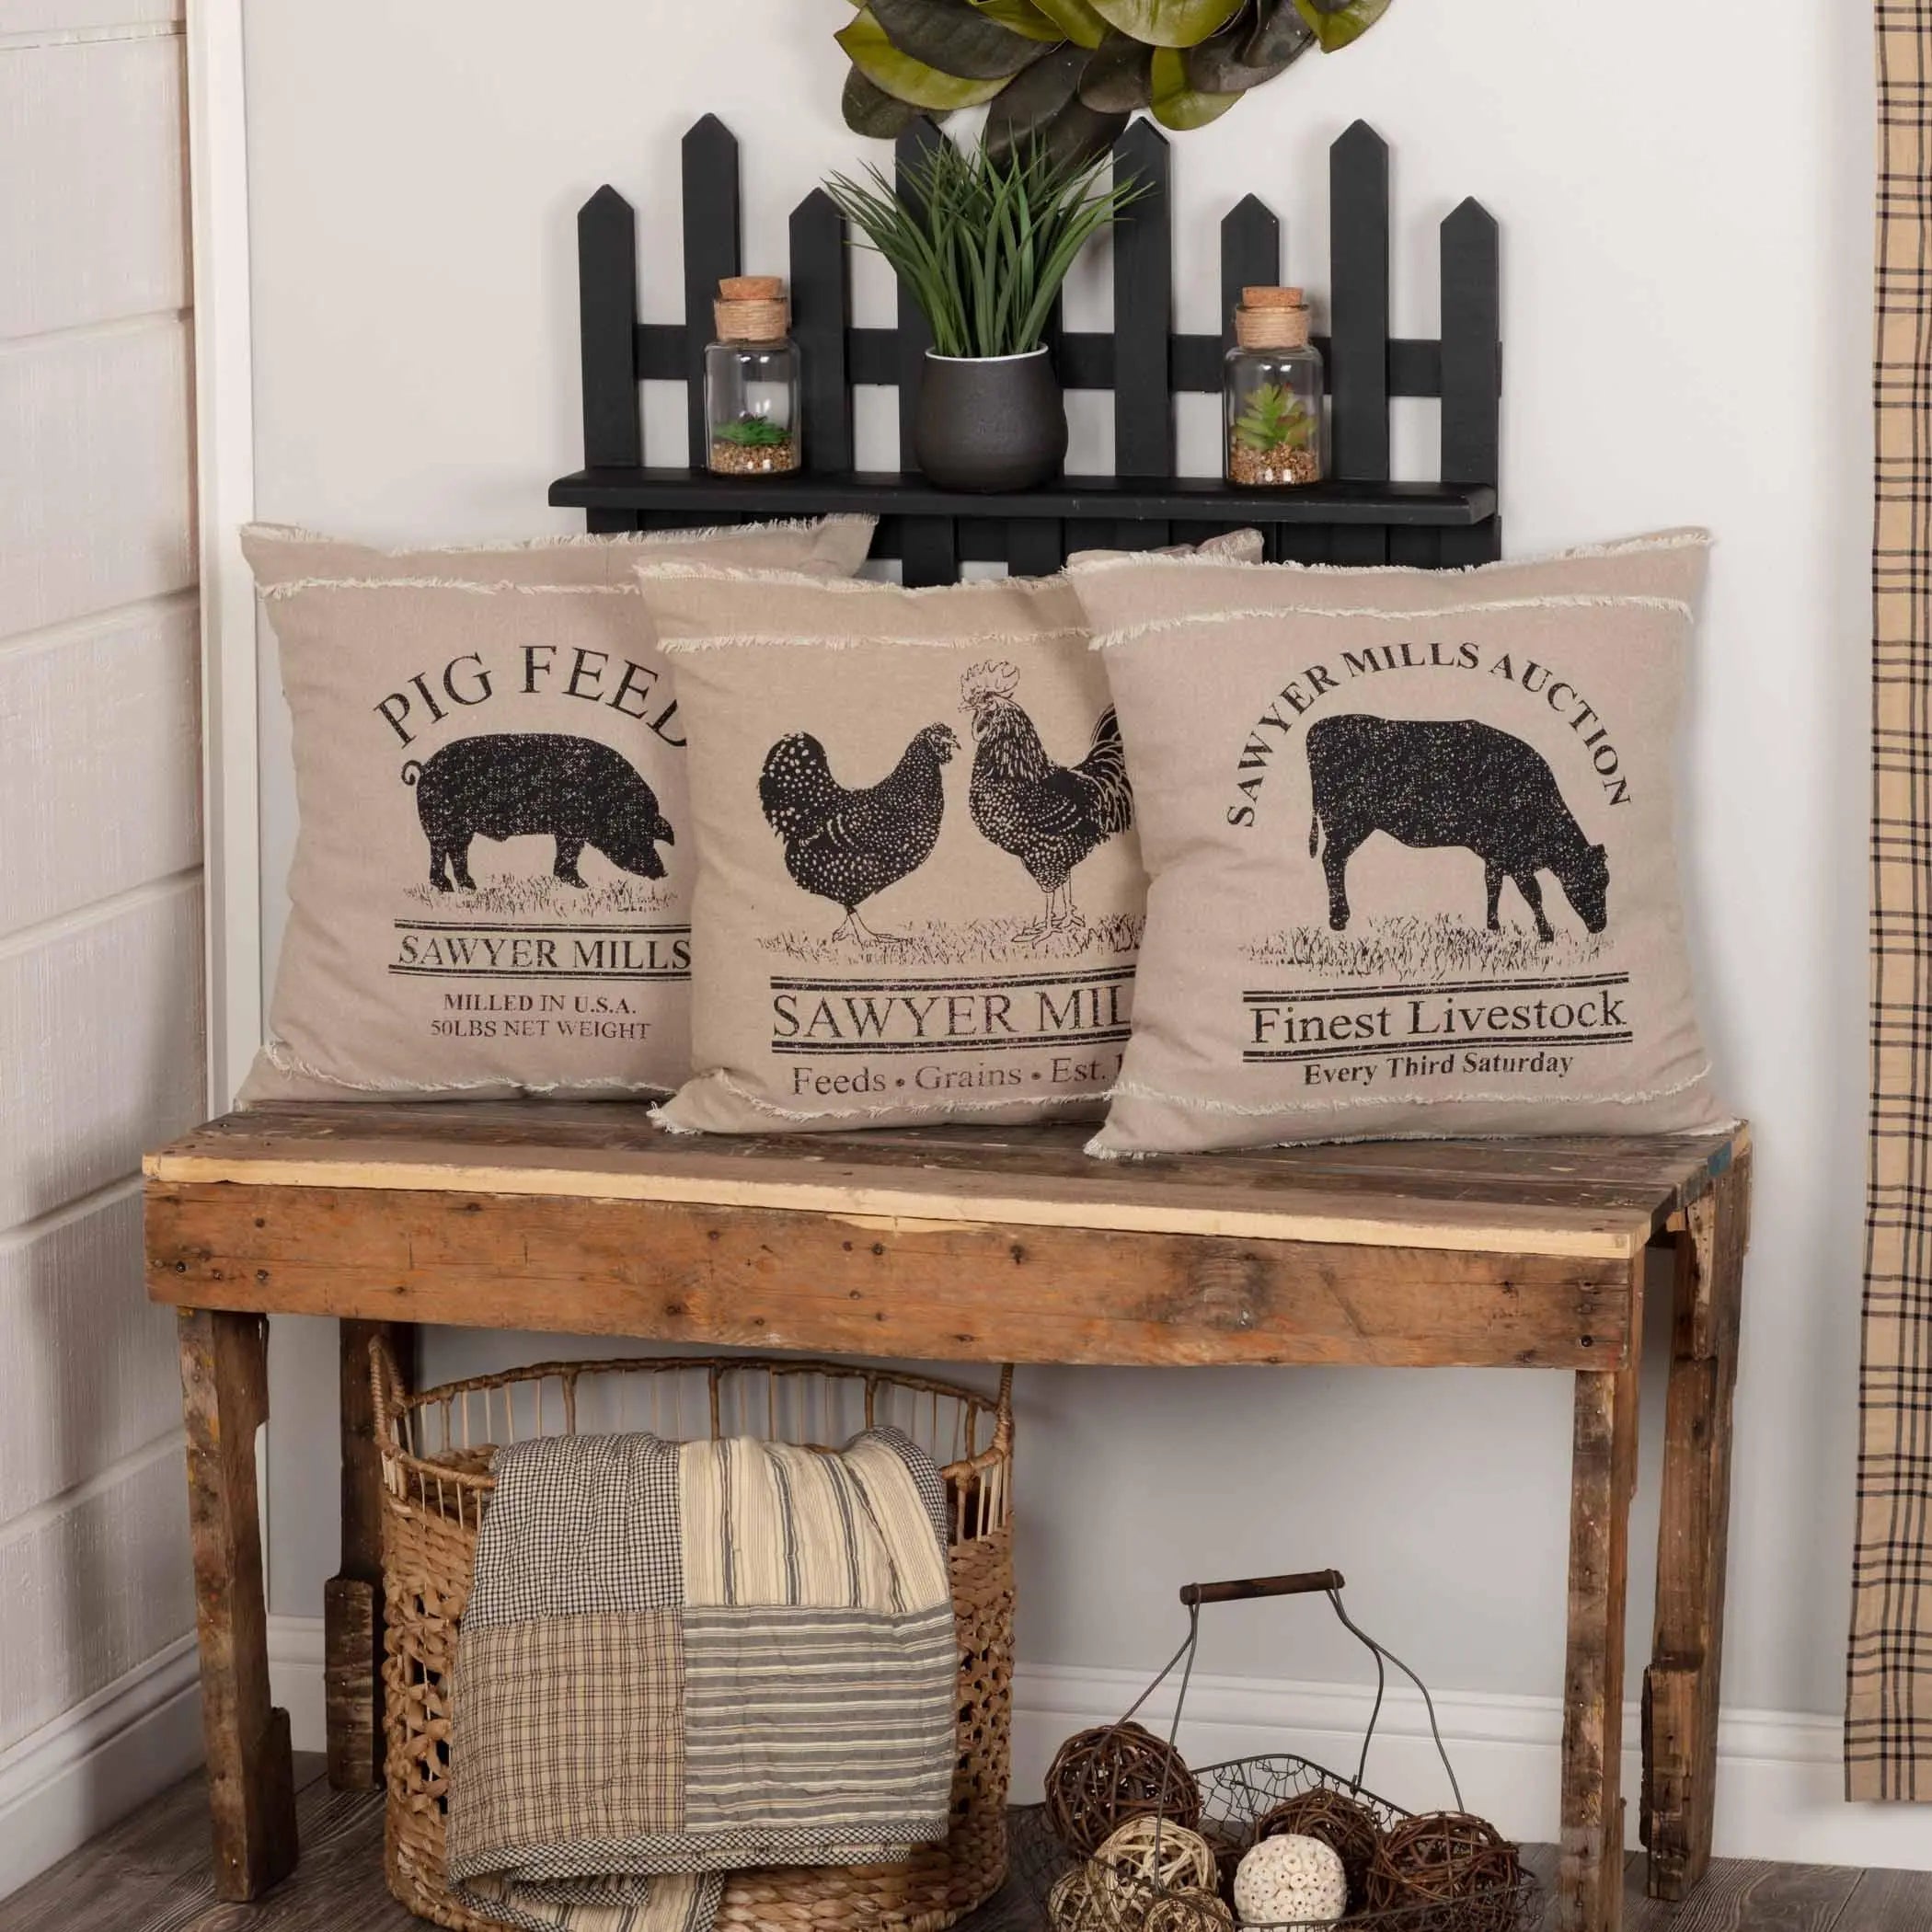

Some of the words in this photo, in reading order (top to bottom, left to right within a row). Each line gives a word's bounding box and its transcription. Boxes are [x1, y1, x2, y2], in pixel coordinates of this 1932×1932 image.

[373, 652, 493, 749] PIG
[1227, 664, 1340, 828] SAWYER
[1340, 642, 1480, 678] MILLS
[1489, 652, 1632, 807] AUCTION
[398, 935, 558, 967] SAWYER
[572, 938, 691, 970] MILLS
[443, 994, 534, 1012] MILLED
[540, 995, 565, 1010] IN
[574, 995, 637, 1015] U.S.A.
[773, 994, 1019, 1039] SAWYER
[1249, 1006, 1392, 1045] Finest
[1407, 990, 1627, 1035] Livestock
[431, 1019, 498, 1037] 50LBS
[503, 1020, 549, 1037] NET
[558, 1020, 650, 1040] WEIGHT
[792, 1066, 886, 1096] Feeds
[915, 1063, 1022, 1089] Grains
[1050, 1057, 1106, 1084] Est.
[1304, 1064, 1378, 1086] Every
[1386, 1054, 1455, 1079] Third
[1463, 1052, 1574, 1078] Saturday
